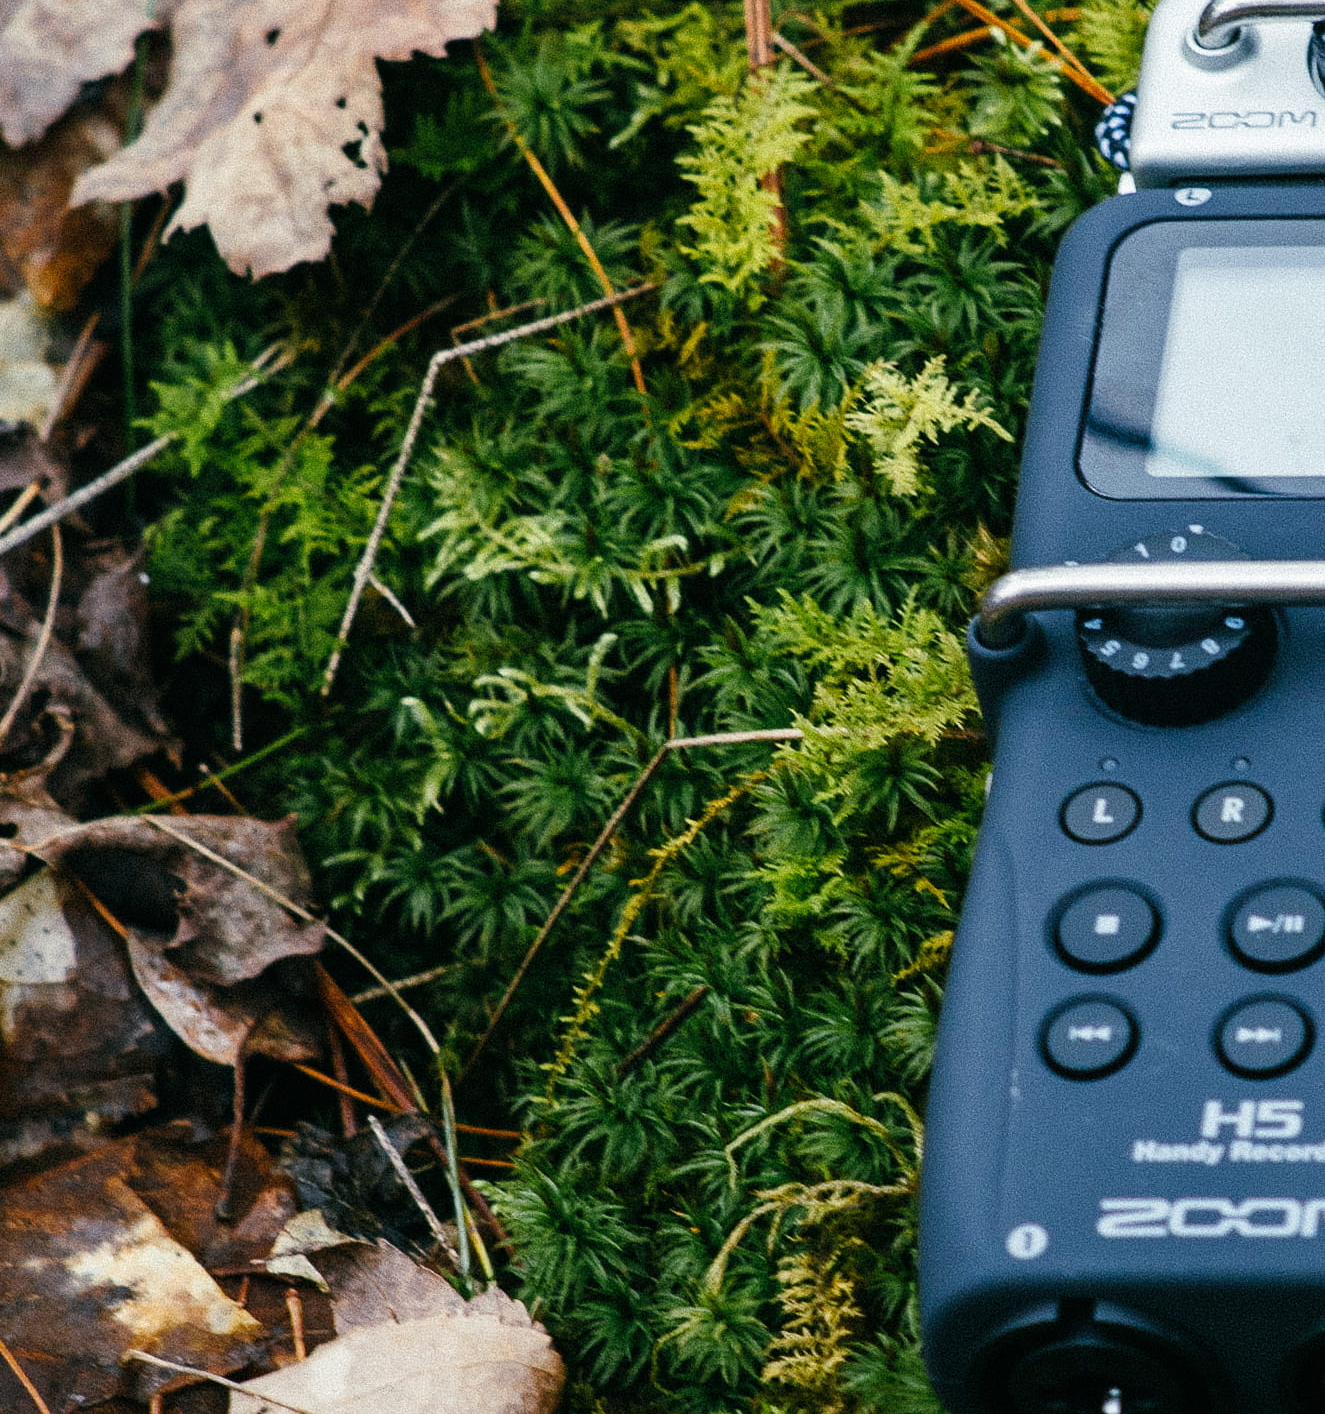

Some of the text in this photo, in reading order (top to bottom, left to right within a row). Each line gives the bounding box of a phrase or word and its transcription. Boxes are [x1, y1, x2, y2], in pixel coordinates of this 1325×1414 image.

[1172, 111, 1316, 130] ZOOM
[1170, 536, 1187, 554] 0
[1093, 798, 1113, 822] L
[1221, 797, 1243, 821] R
[1201, 1098, 1304, 1138] H5
[1132, 1139, 1224, 1166] Handy
